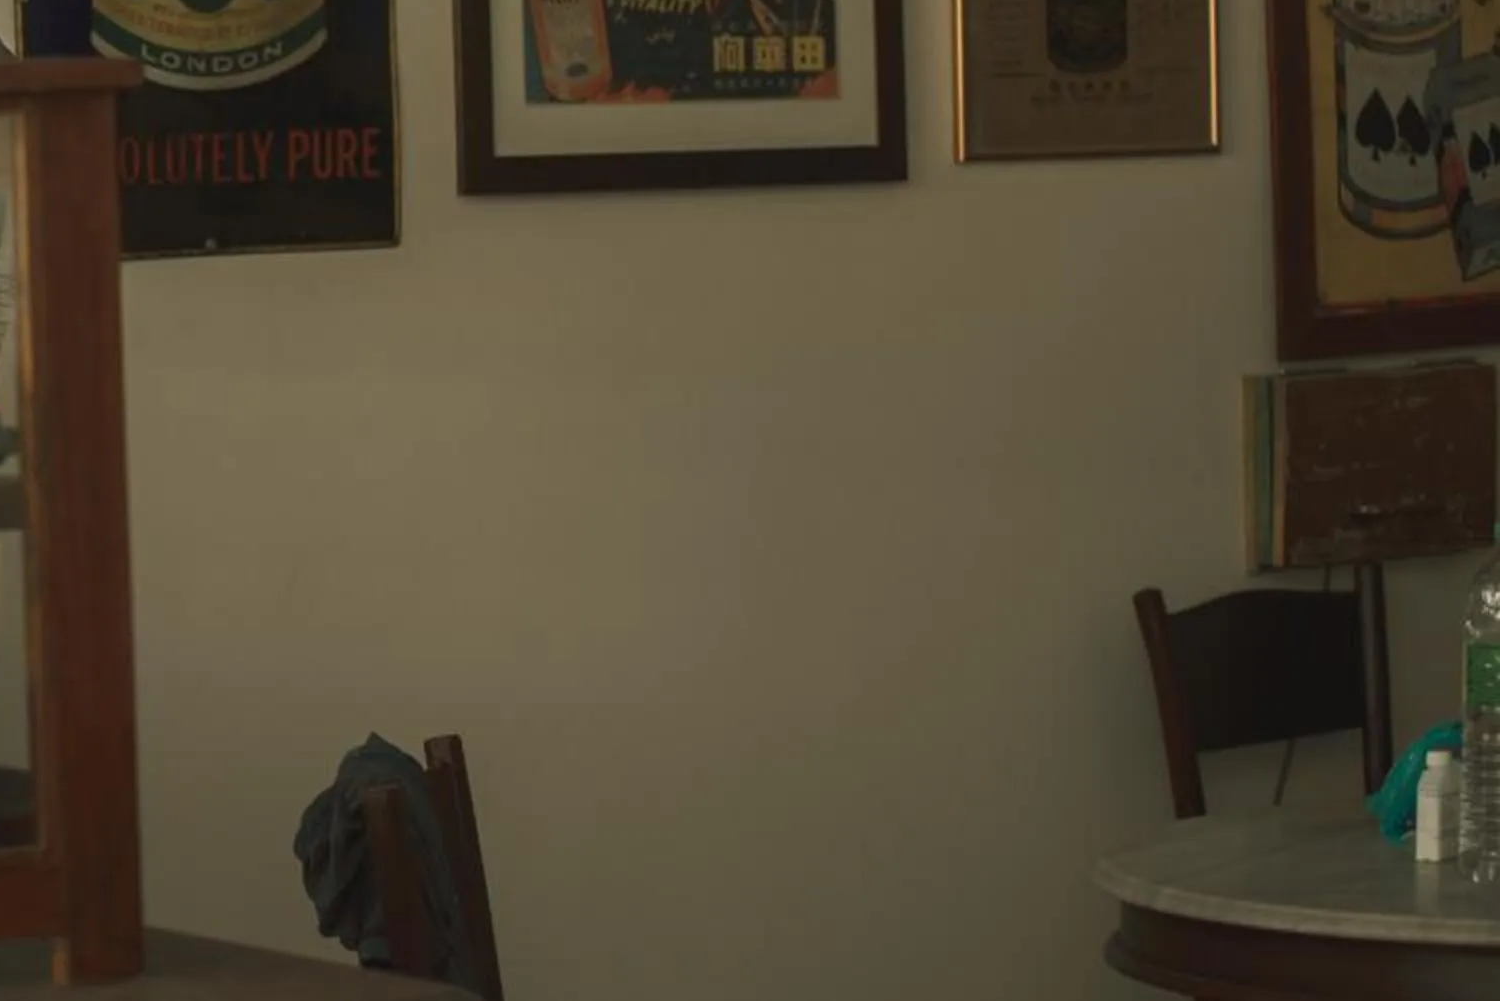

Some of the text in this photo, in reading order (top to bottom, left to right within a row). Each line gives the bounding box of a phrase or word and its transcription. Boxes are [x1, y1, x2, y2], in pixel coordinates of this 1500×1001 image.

[141, 40, 284, 72] LONDON
[119, 126, 382, 186] OLUTELY PURE
